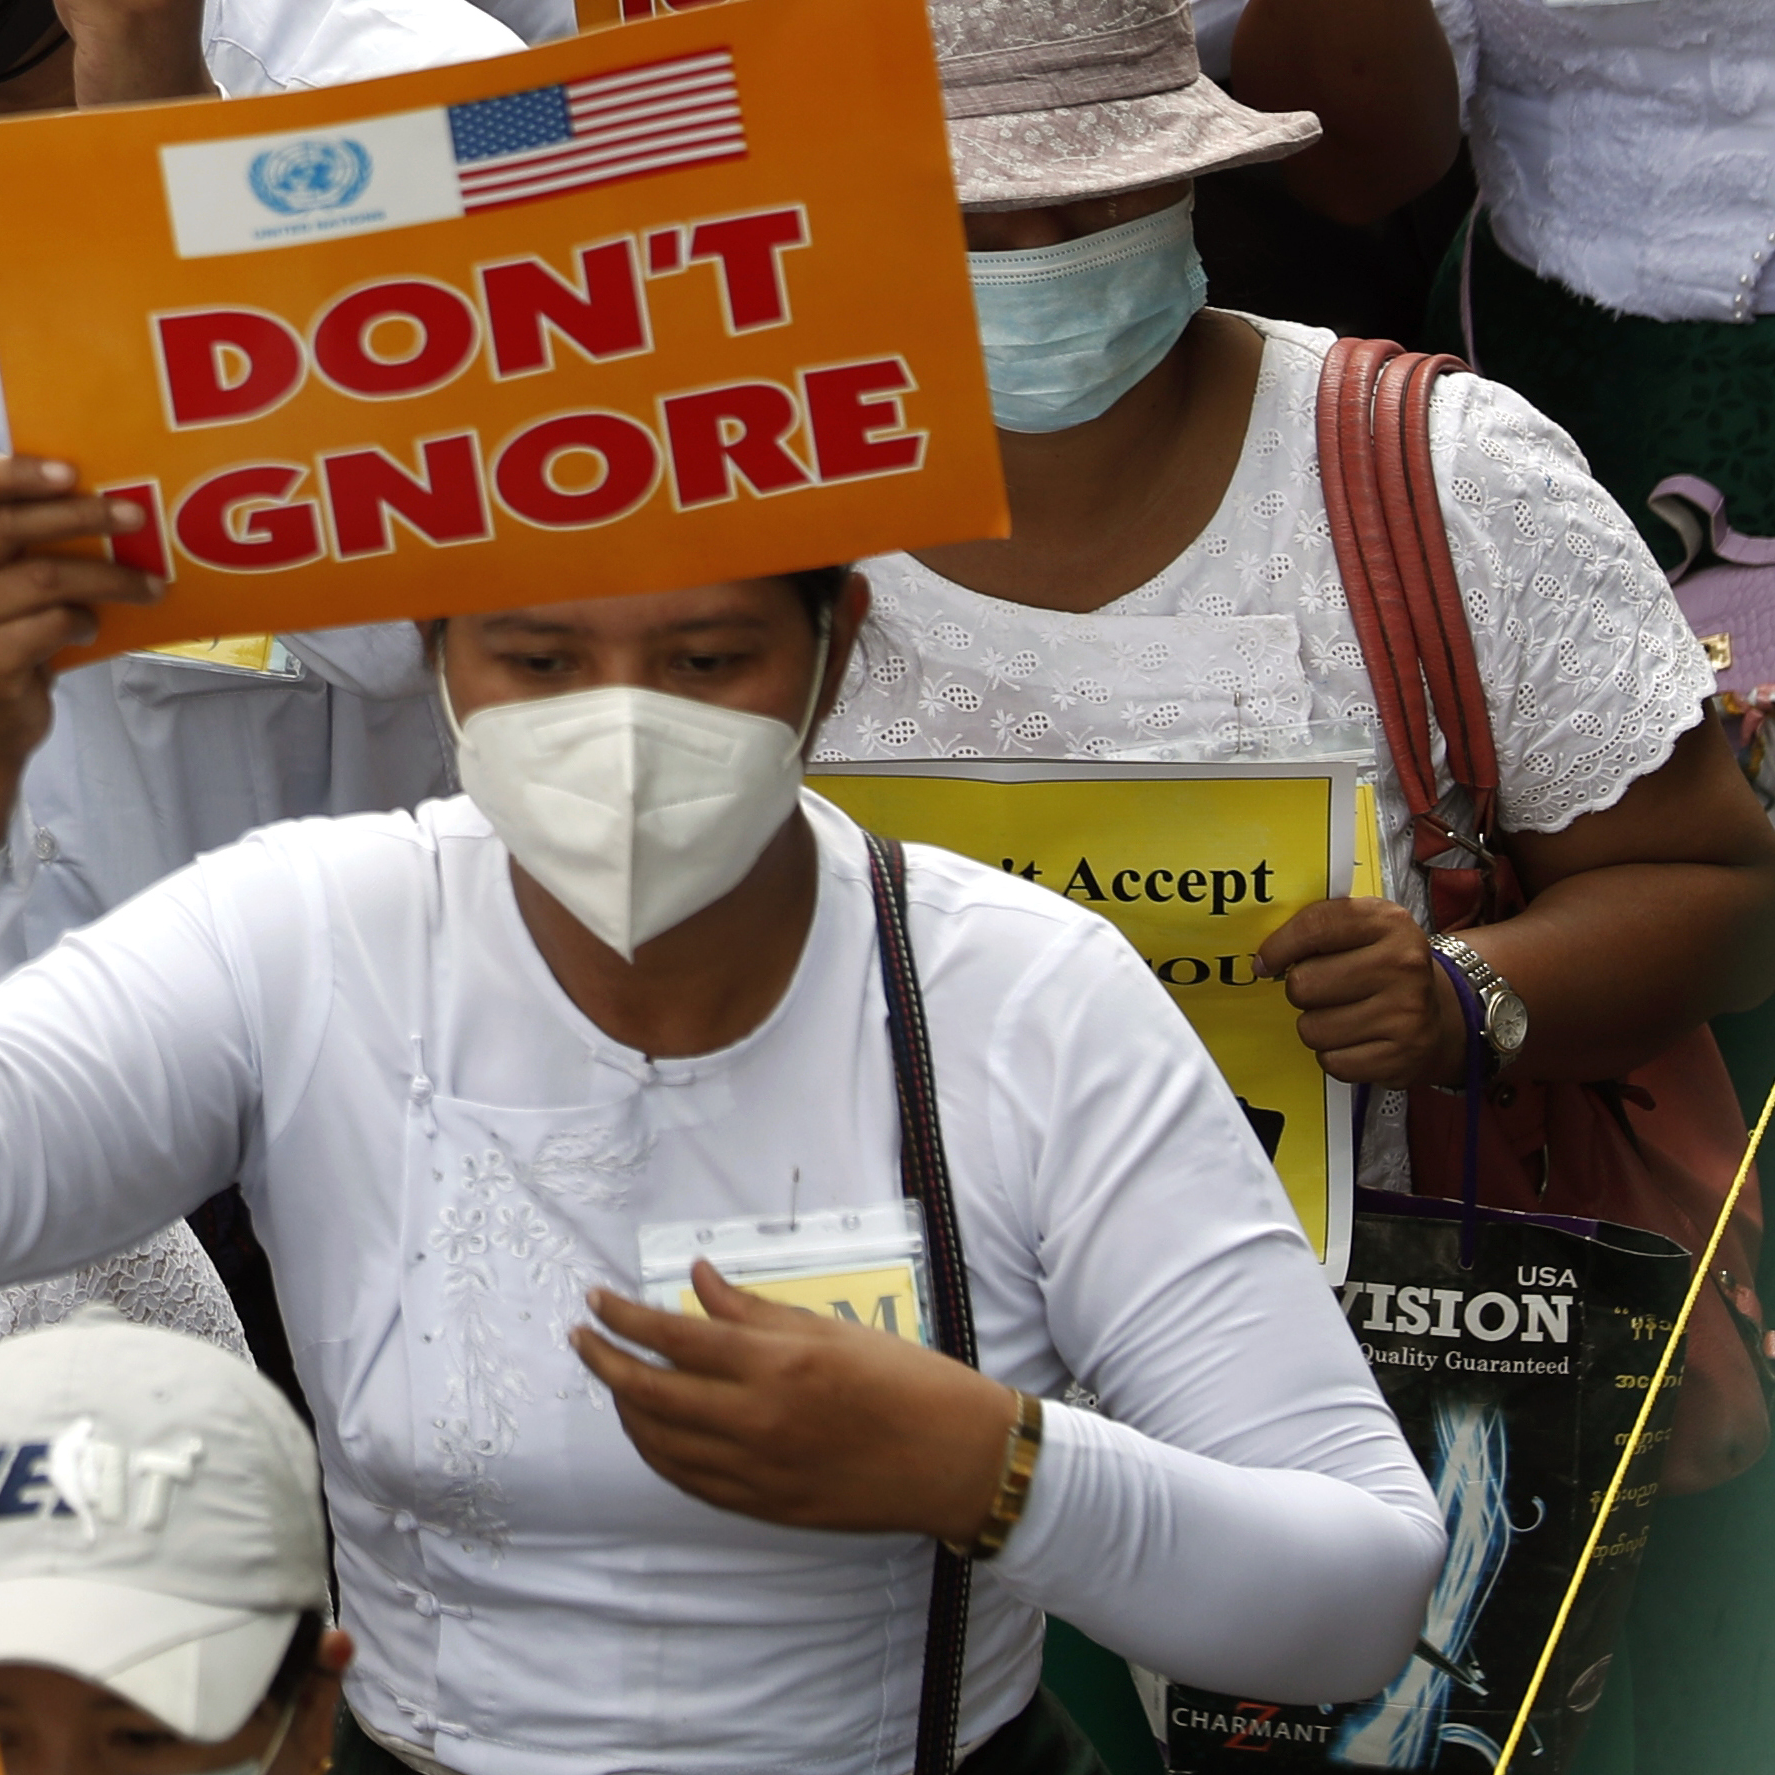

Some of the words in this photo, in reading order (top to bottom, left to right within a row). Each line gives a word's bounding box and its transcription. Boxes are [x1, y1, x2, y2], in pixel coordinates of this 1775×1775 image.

[151, 203, 811, 432] DON'T
[100, 354, 929, 584] IGNORE
[1064, 857, 1274, 915] Accept
[1517, 1265, 1578, 1288] USA
[1360, 1343, 1439, 1371] Quality
[1444, 1350, 1569, 1375] Guaranteed
[1170, 1706, 1331, 1744] CHARMANT
